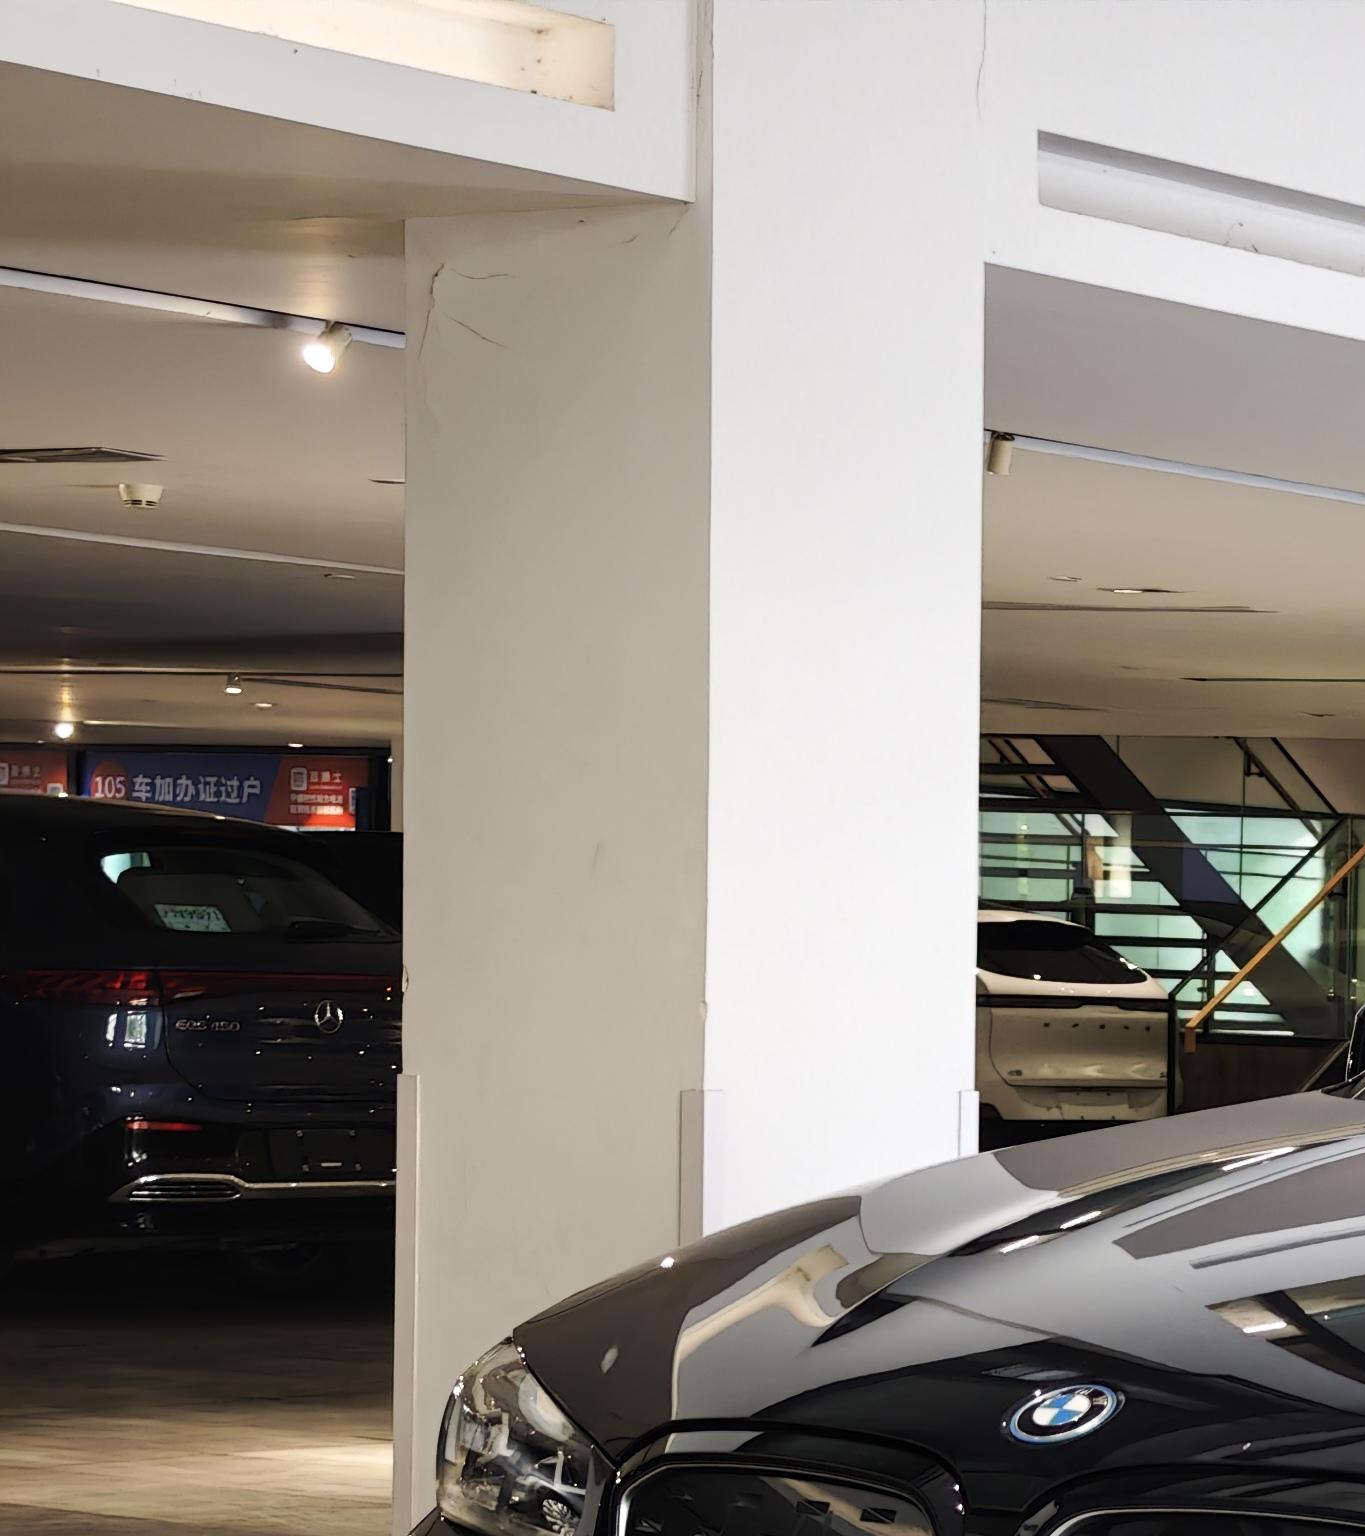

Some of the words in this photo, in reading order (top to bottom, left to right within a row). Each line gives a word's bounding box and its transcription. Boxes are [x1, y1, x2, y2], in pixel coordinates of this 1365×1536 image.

[95, 776, 126, 799] 105
[132, 774, 261, 803] 车加办证过户
